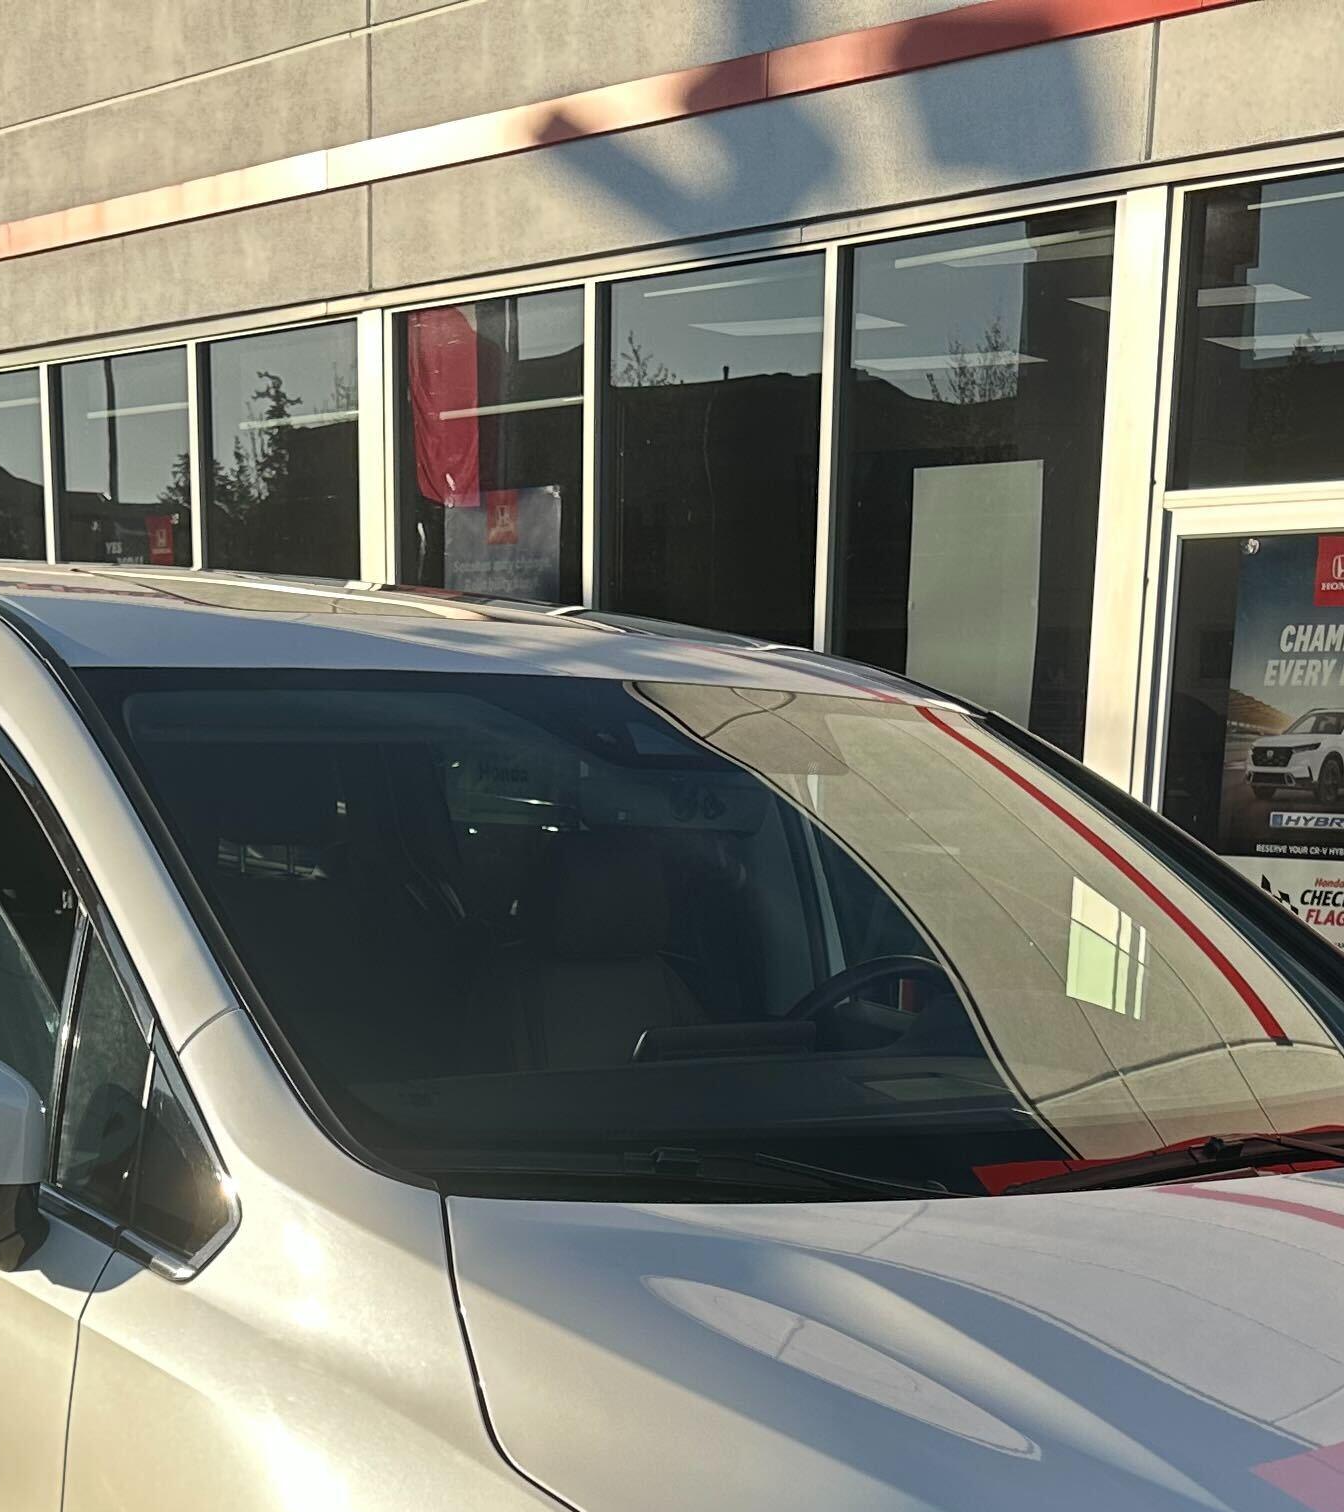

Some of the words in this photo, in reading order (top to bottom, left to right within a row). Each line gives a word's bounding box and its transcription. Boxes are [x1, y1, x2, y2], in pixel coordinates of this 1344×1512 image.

[1263, 658, 1337, 687] EVERY
[1256, 844, 1287, 855] RESERVE
[1289, 845, 1308, 855] YOUR
